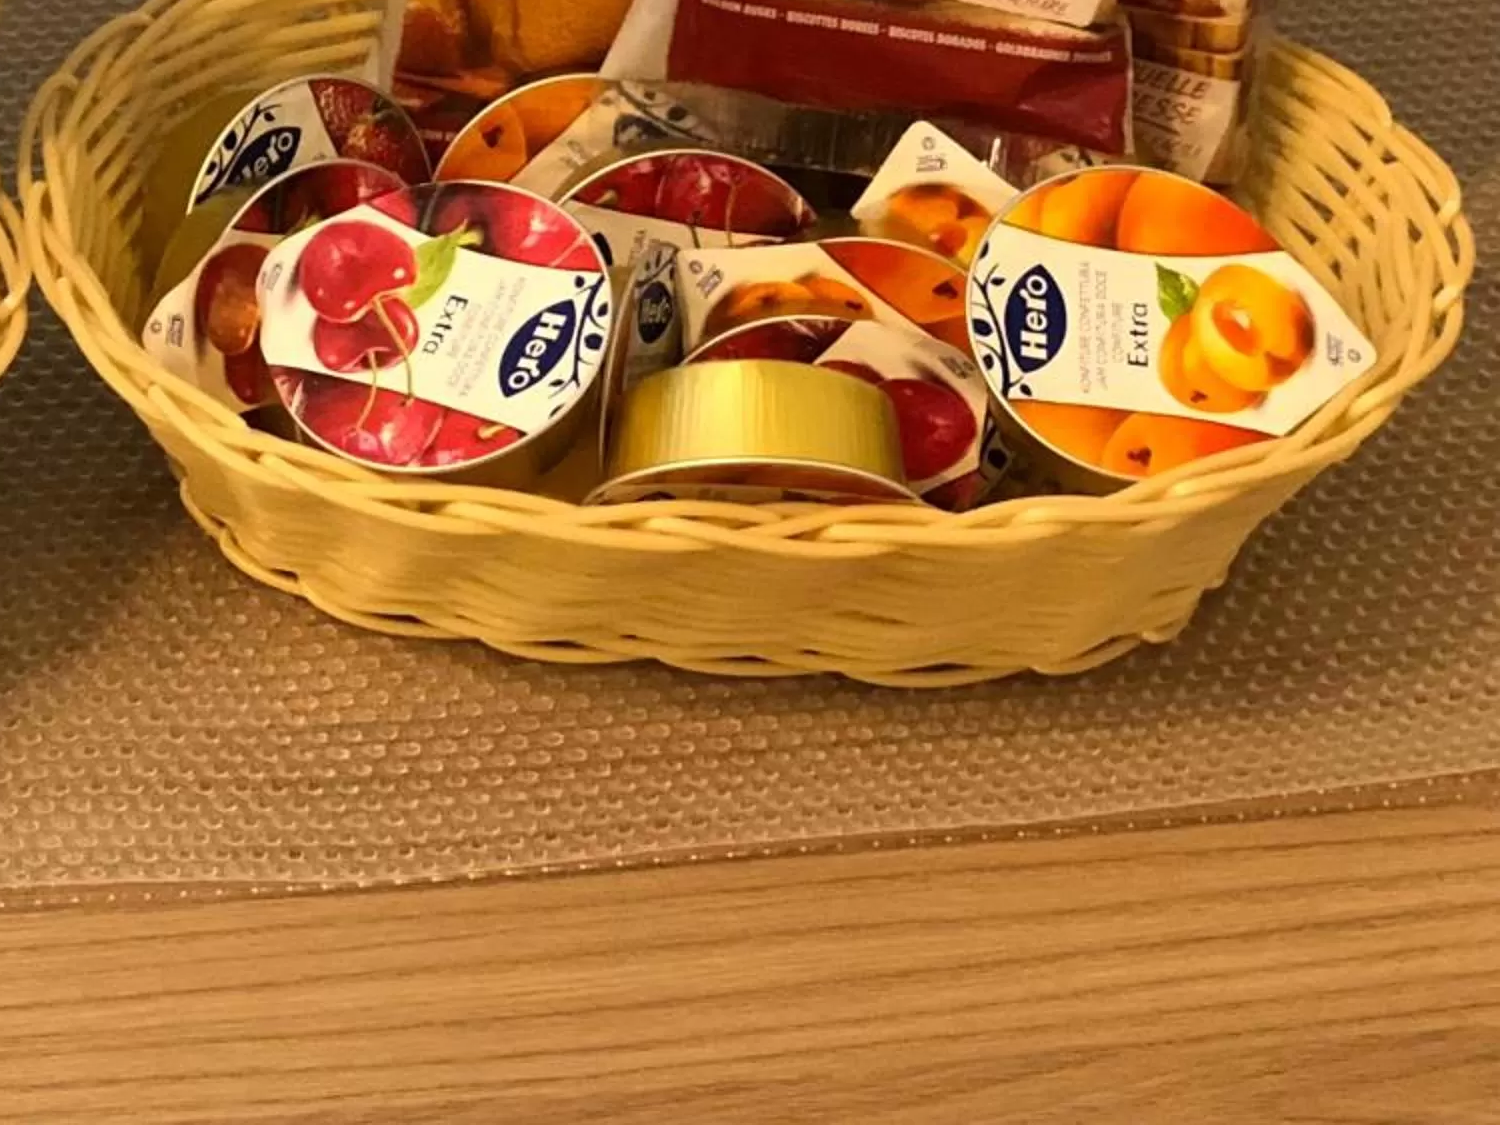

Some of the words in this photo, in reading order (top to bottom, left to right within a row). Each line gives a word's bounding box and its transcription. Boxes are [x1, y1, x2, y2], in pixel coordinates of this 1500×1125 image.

[422, 294, 468, 356] Extra
[507, 311, 567, 390] Hero
[1018, 275, 1048, 362] Hero
[1127, 302, 1150, 369] Extra
